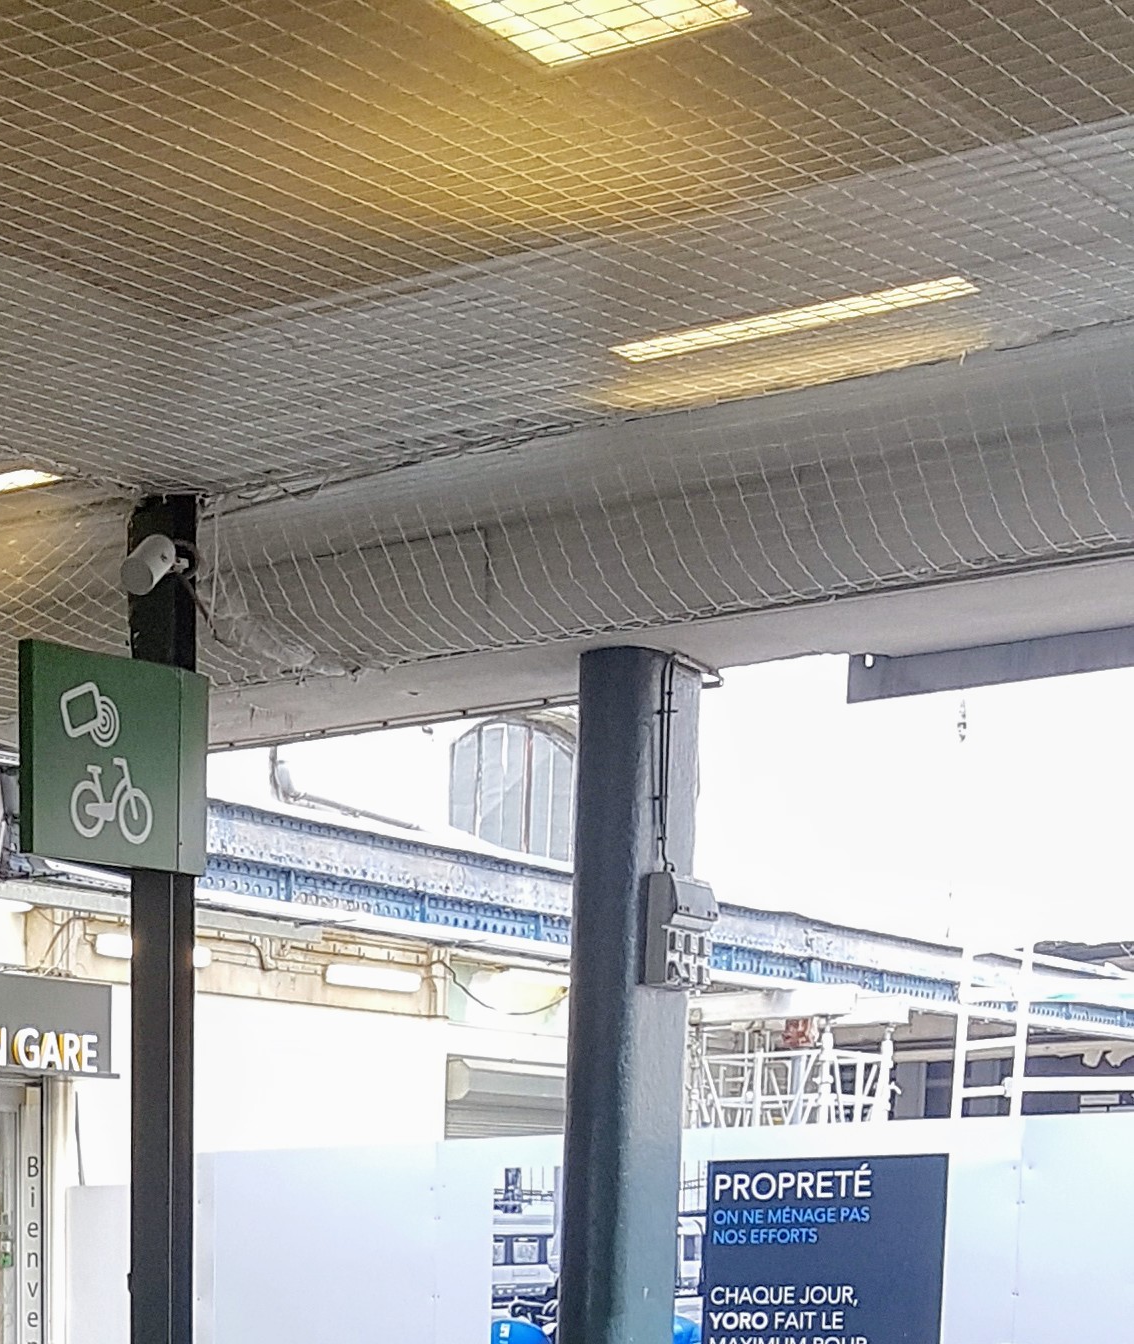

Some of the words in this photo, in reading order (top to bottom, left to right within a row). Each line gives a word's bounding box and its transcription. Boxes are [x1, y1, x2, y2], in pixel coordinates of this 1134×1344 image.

[15, 1027, 98, 1074] GARE
[714, 1163, 872, 1201] PROPRETÉ
[713, 1210, 739, 1225] ON
[742, 1209, 764, 1224] NE
[767, 1206, 837, 1223] MÉNAGE
[840, 1207, 871, 1222] PAS
[713, 1229, 747, 1245] NOS
[749, 1228, 818, 1244] EFFORTS
[710, 1287, 796, 1306] CHAQUE
[799, 1286, 858, 1307] JOUR,
[709, 1312, 768, 1330] YORO
[773, 1312, 817, 1330] FAIT
[821, 1311, 844, 1330] LE
